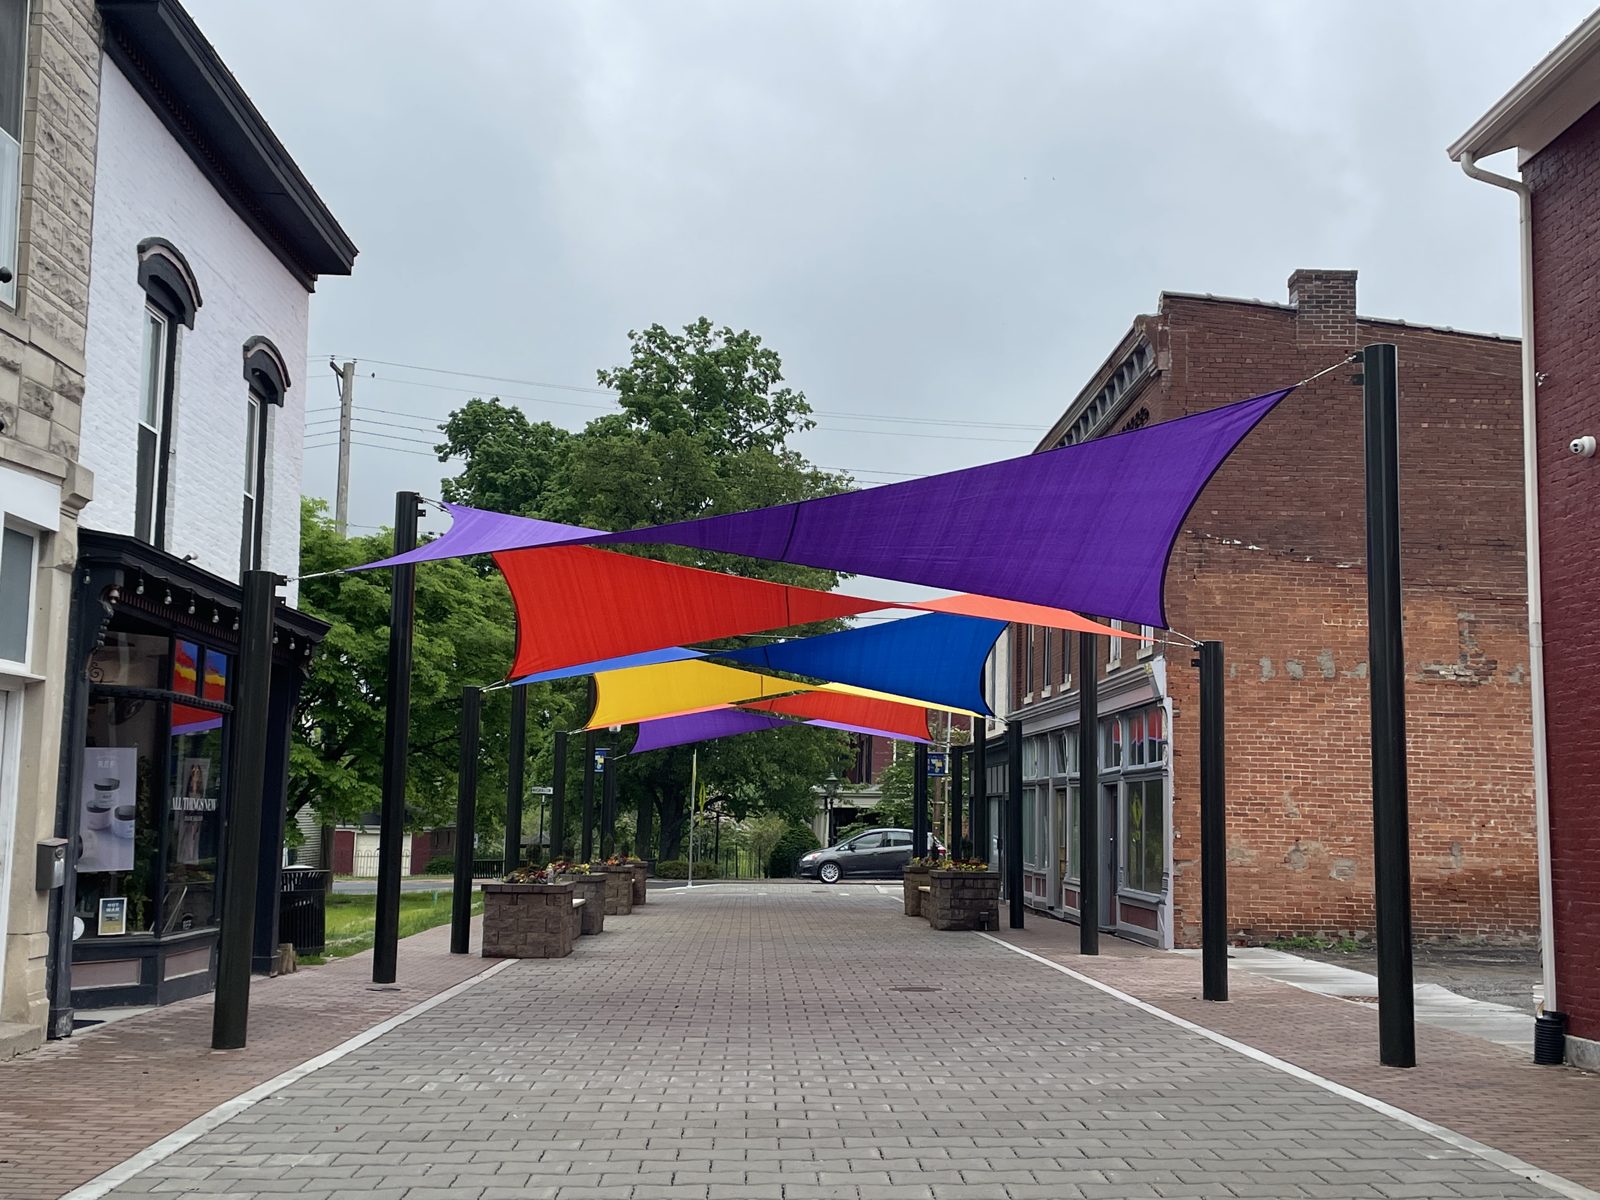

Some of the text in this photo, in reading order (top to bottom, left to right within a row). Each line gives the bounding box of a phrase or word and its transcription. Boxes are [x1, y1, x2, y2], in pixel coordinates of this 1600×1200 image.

[171, 796, 217, 811] ALL THINGS NEW
